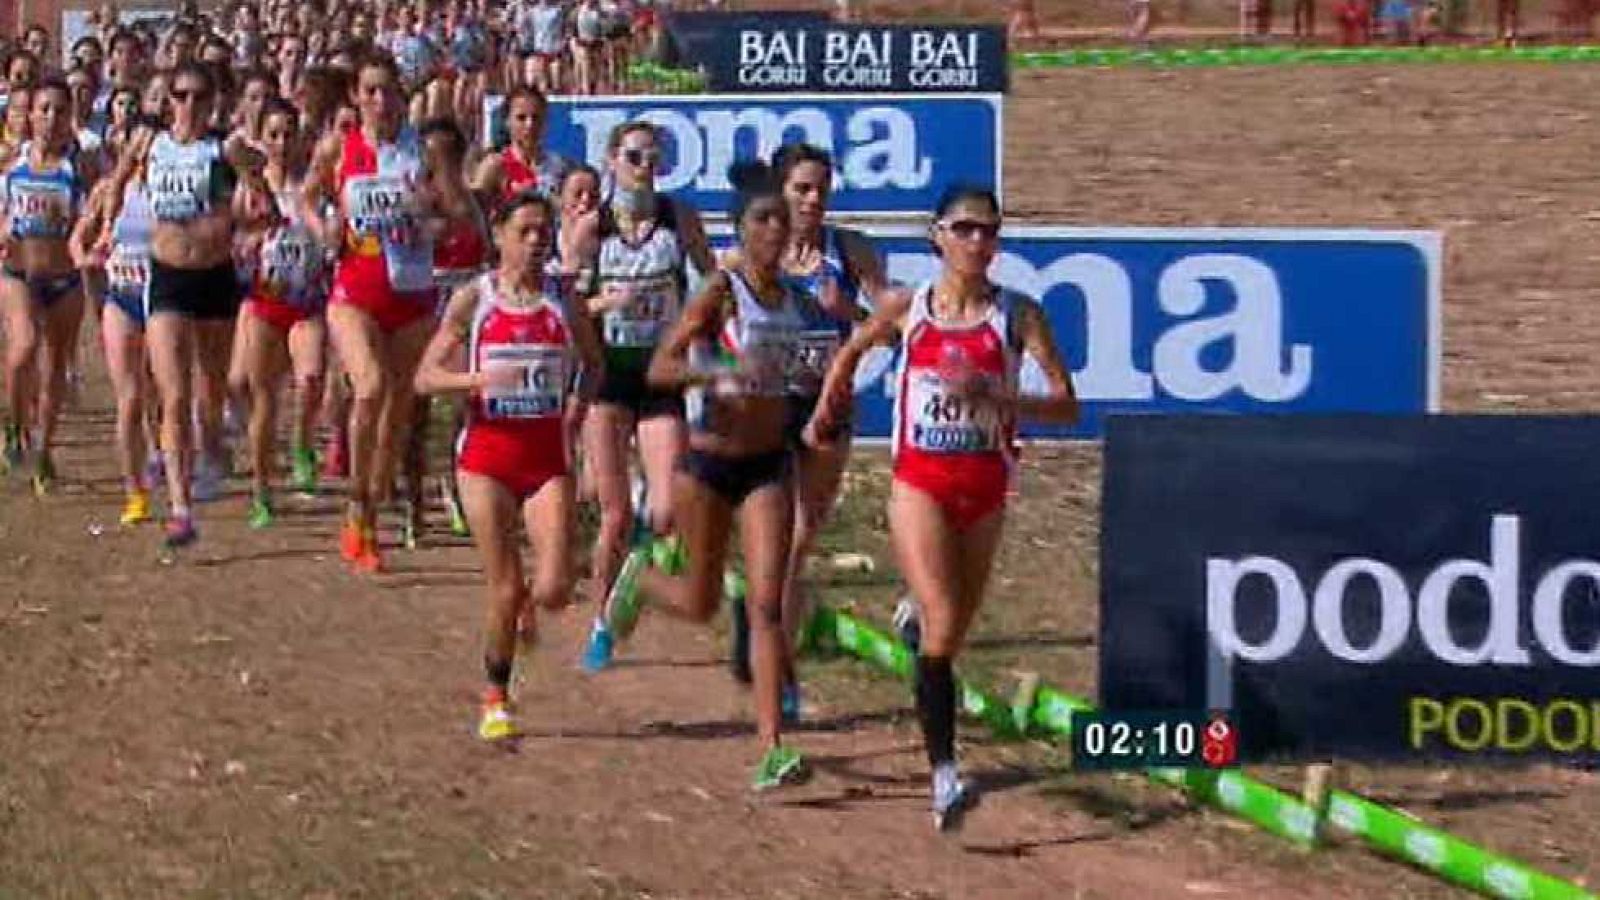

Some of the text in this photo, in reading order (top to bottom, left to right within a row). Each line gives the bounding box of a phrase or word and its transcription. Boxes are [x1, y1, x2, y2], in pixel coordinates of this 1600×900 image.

[740, 31, 977, 67] BAI BAI BAI
[1206, 514, 1600, 710] podo
[1411, 697, 1600, 751] PODO
